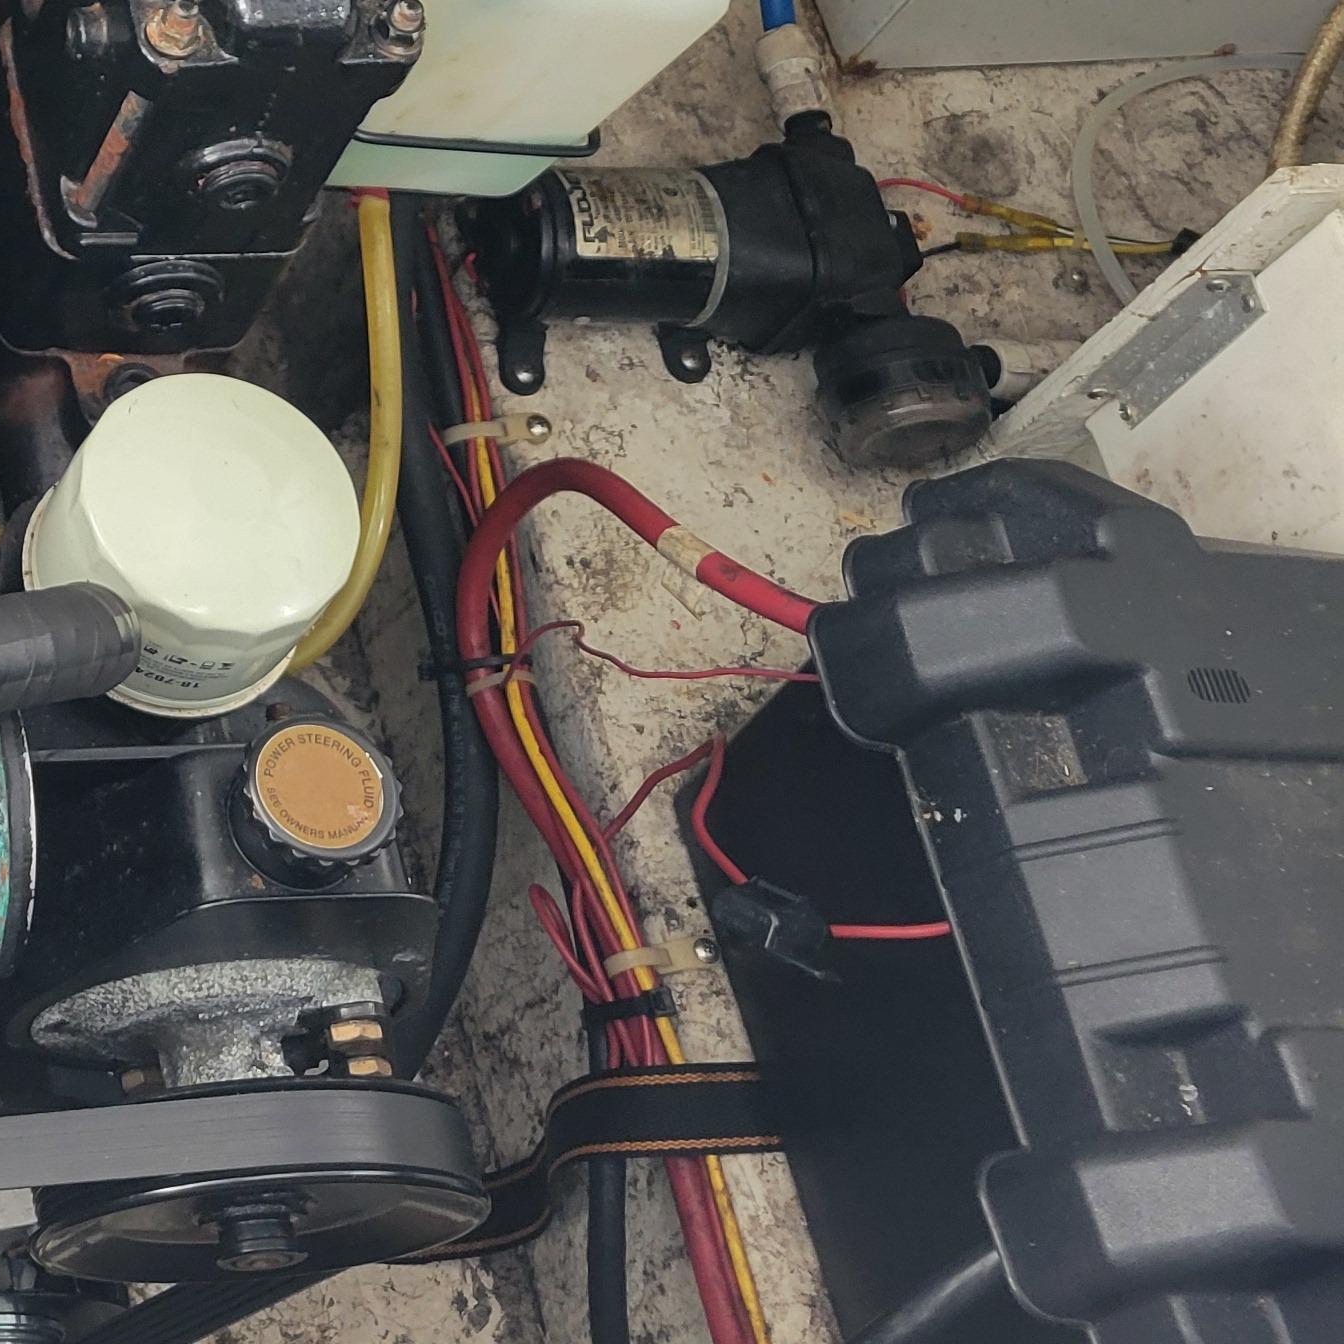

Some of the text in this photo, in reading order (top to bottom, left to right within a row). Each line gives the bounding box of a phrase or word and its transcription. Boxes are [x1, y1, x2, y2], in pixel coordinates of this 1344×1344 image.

[263, 733, 375, 809] POWER STEERING FLUID
[267, 787, 283, 809] SEE
[279, 809, 325, 839] OWNERS
